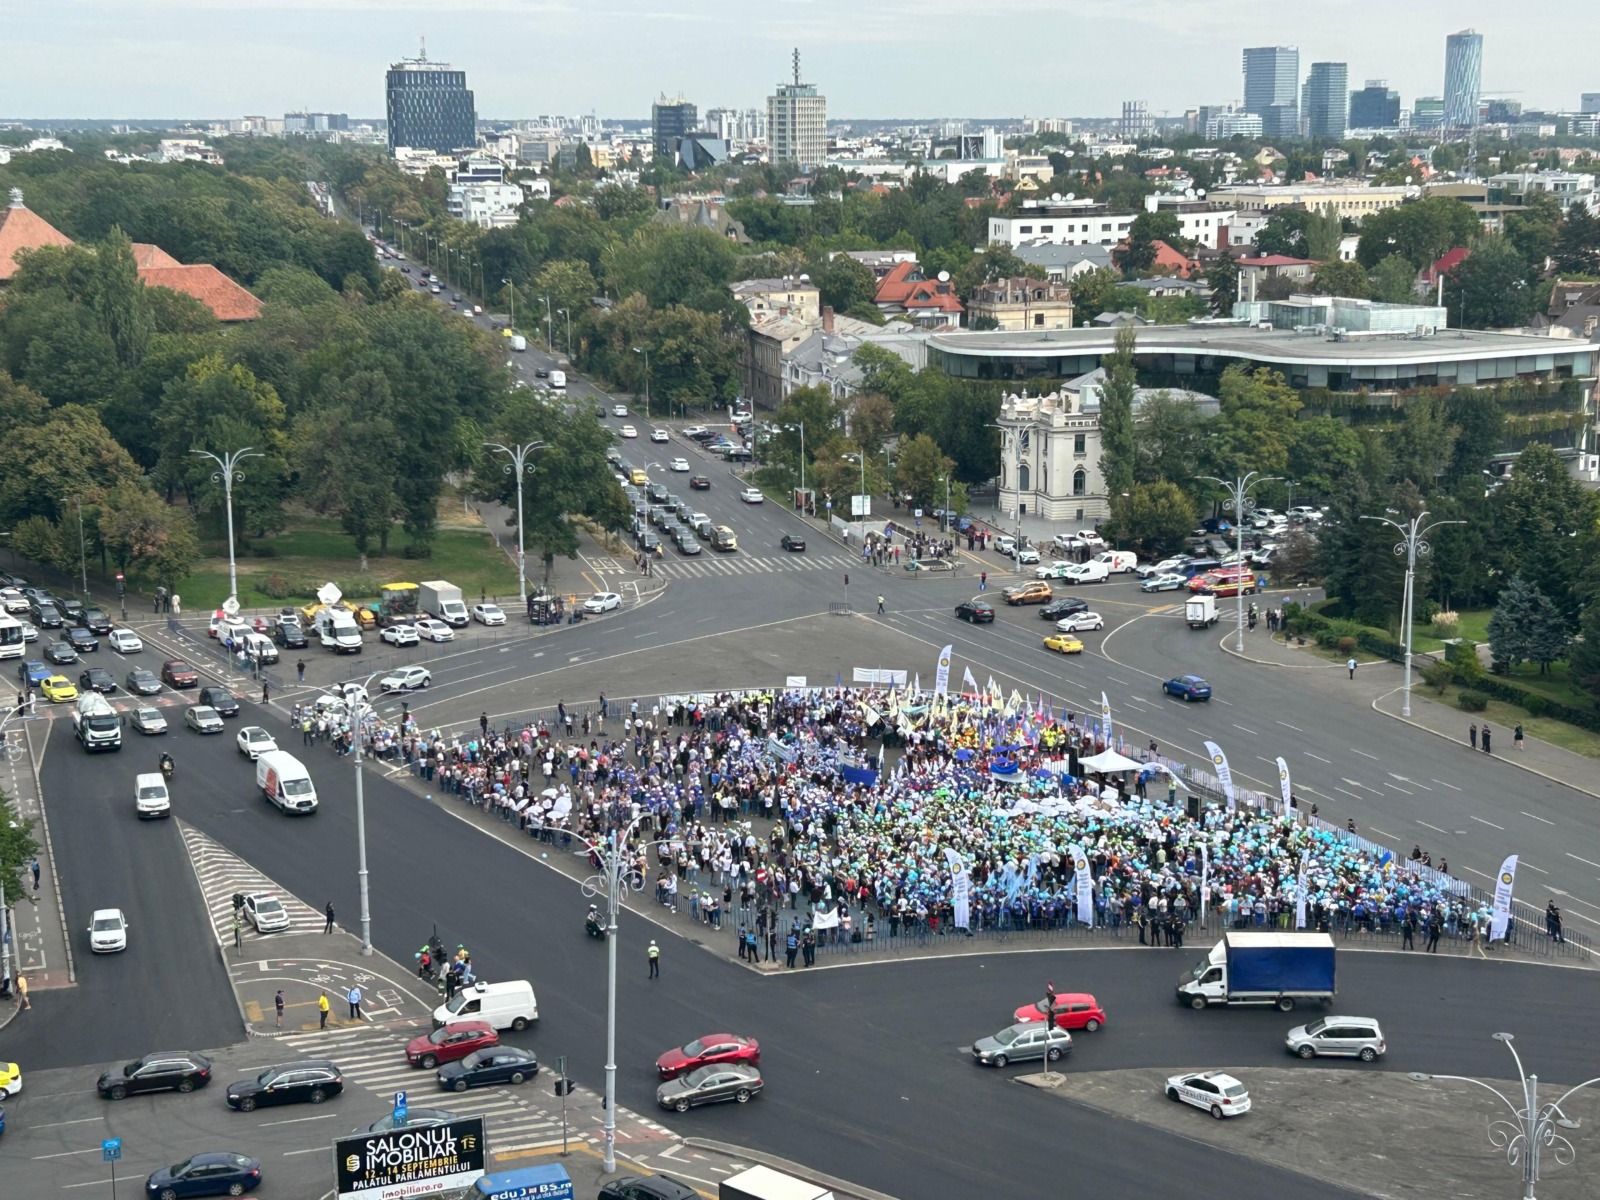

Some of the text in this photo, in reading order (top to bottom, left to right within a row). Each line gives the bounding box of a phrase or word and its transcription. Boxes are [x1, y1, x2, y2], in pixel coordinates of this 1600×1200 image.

[366, 1127, 457, 1155] SALONUL
[365, 1170, 376, 1179] 12
[387, 1166, 398, 1175] 14
[401, 1155, 458, 1173] SEPTEMBRIE
[366, 1141, 457, 1170] IMOBILIAR
[352, 1161, 470, 1190] PALATUL PARLAMENTULUI
[382, 1183, 443, 1199] imobiliare.ro
